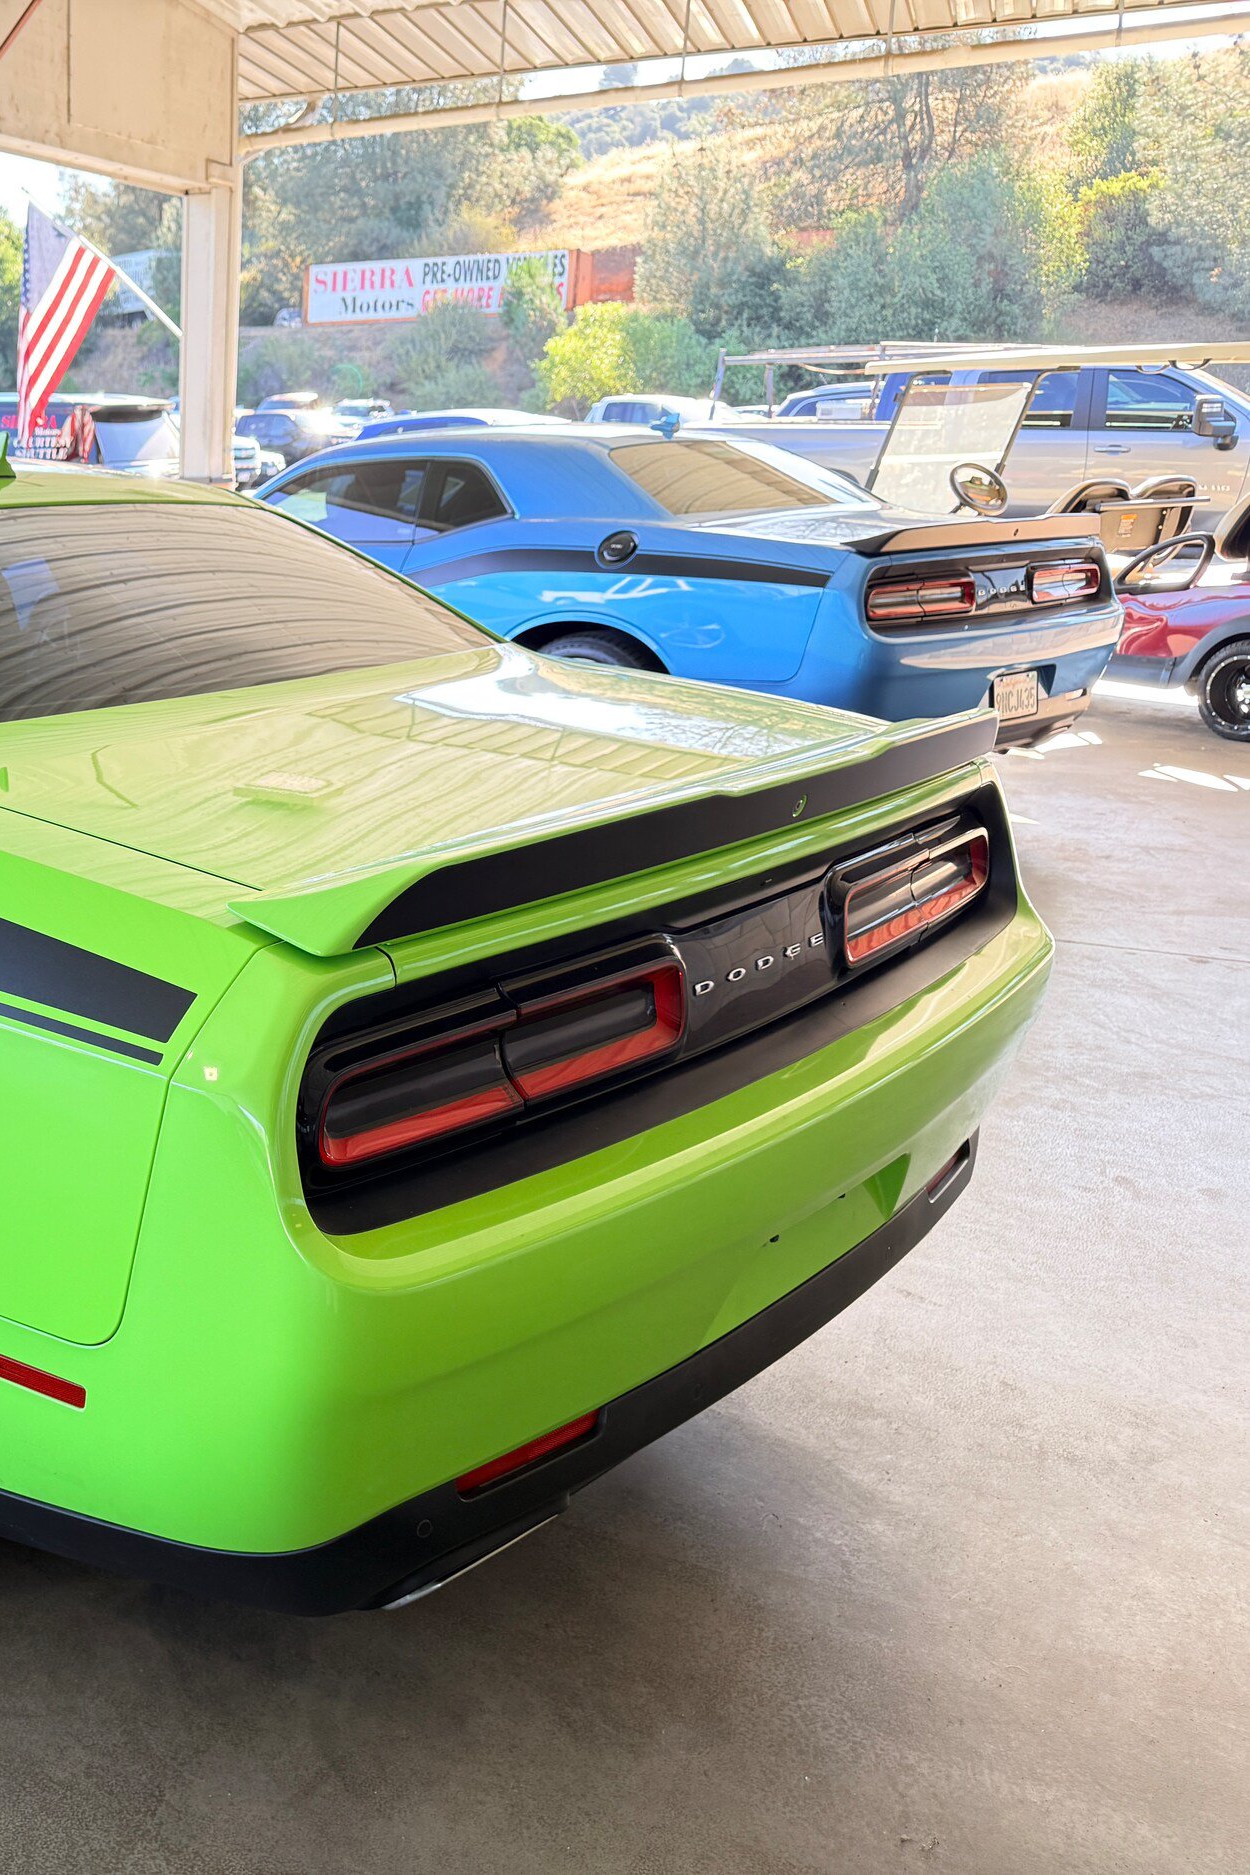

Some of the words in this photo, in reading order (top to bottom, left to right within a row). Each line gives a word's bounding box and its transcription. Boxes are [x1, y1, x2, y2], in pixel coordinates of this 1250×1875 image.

[313, 264, 415, 295] SIERRA
[421, 257, 502, 286] PRE-OWNED
[338, 295, 416, 316] Motors
[693, 931, 826, 997] DODGE
